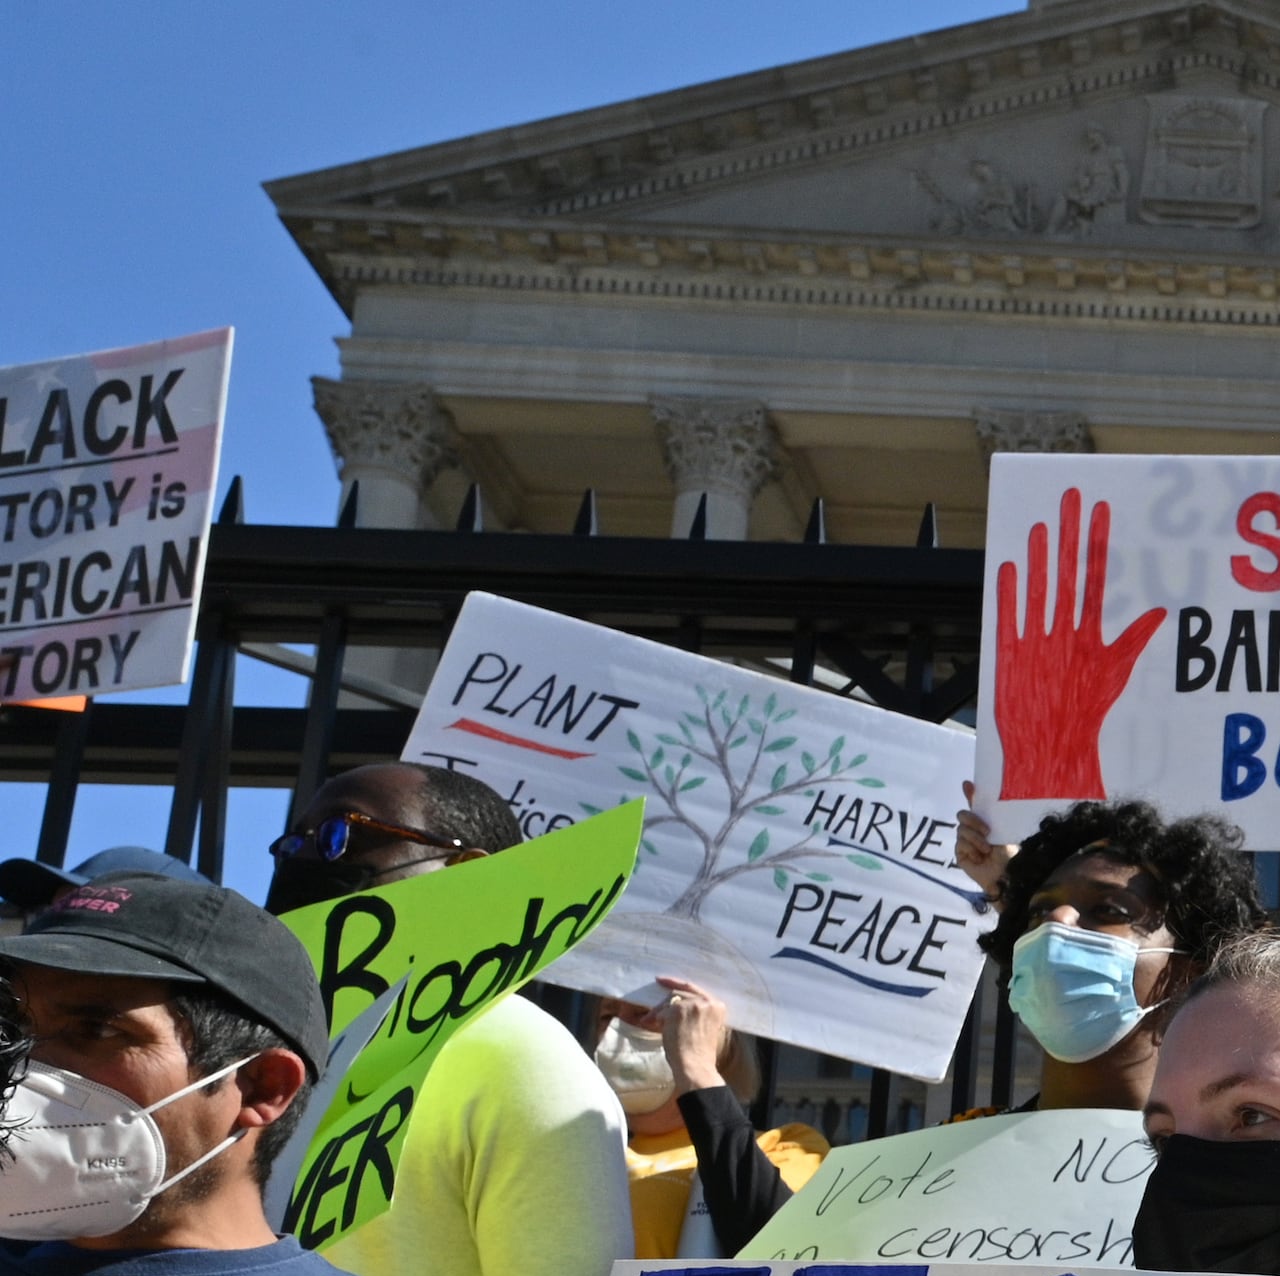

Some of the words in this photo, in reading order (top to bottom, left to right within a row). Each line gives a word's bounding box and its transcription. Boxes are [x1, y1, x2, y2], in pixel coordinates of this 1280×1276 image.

[148, 473, 187, 521] is
[451, 652, 640, 743] PLANT
[803, 789, 962, 869] HARVE
[775, 883, 968, 980] PEACE
[86, 1156, 127, 1170] KN95
[815, 1151, 957, 1217] Vote
[1053, 1136, 1158, 1185] NO
